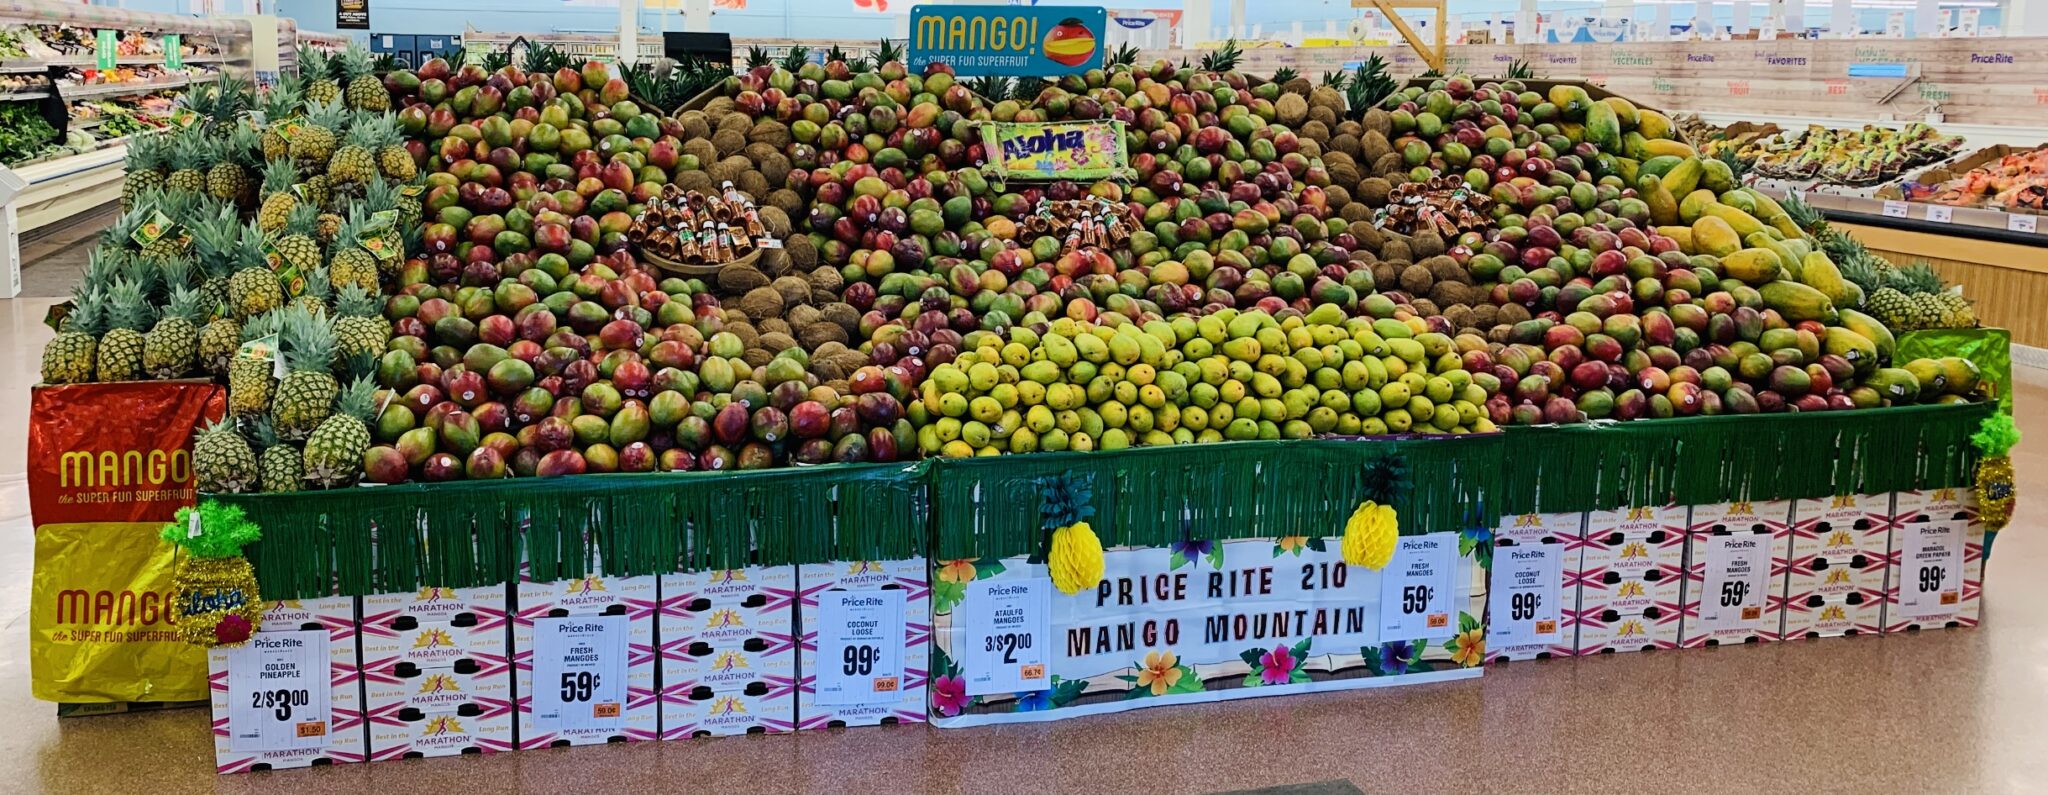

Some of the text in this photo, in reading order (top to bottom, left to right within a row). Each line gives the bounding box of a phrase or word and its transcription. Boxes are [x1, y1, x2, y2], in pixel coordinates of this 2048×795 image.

[916, 15, 1038, 55] MANGO!
[913, 55, 1028, 67] the SUPER FUN SUPERFRUIT
[1613, 57, 1653, 66] VEGETABLES
[1767, 57, 1806, 66] FAVORITES
[1729, 87, 1750, 96] FRUIT
[1920, 90, 1950, 100] FRESH
[1002, 128, 1085, 161] Aloha
[60, 449, 198, 488] MANGO
[58, 488, 193, 504] the SUPER FUN SUPERFRUIT
[1825, 511, 1862, 519] MARATHON
[1508, 528, 1549, 536] MARATHON
[1920, 526, 1951, 535] Price Rite
[1403, 540, 1439, 550] Price Rite
[1724, 540, 1756, 549] Price Rite
[1511, 550, 1530, 560] Price
[1915, 552, 1932, 560] GREEN
[1613, 560, 1653, 568] MARATHON
[1406, 569, 1434, 577] MANGOES
[1514, 570, 1541, 578] COCONUT
[840, 574, 889, 585] MARATHON
[1096, 560, 1348, 608] PRICE RITE 210
[1919, 565, 1946, 593] 99¢
[703, 585, 755, 595] MARATHON
[988, 585, 1029, 596] Price Rite
[1720, 580, 1750, 607] 59¢
[1818, 584, 1855, 593] MARATHON
[561, 596, 615, 606] MARATHON
[841, 596, 884, 607] Price Rite
[1402, 585, 1434, 615] 59¢
[1612, 599, 1651, 607] MARATHON
[408, 603, 464, 612] MARATHON
[1511, 592, 1542, 621] 99¢
[261, 612, 310, 622] ARATHON
[995, 608, 1023, 617] ATAULFO
[847, 620, 879, 628] COCONUT
[993, 616, 1025, 625] MANGOES
[1814, 621, 1852, 629] MARATHON
[558, 622, 604, 633] Price Rite
[852, 628, 873, 636] LOOSE
[1067, 606, 1366, 657] MANGO MOUNTAIN
[52, 629, 185, 643] the SUPER FUN SUPERFRU
[701, 628, 752, 639] MARATHON
[254, 637, 303, 649] Price Rite
[1610, 637, 1649, 645] MARATHON
[408, 648, 463, 658] MARATHON
[570, 646, 594, 655] FRESH
[1504, 644, 1545, 653] MARATHON
[563, 653, 599, 663] MANGOES
[843, 645, 880, 676] 99¢
[265, 663, 296, 671] GOLDEN
[260, 670, 301, 679] PINEAPPLE
[704, 672, 755, 682] MARATHON
[561, 671, 601, 703] 59¢
[412, 693, 467, 704] MARATHON
[838, 707, 888, 716] MARATHON
[704, 715, 755, 725] MARATHON
[300, 725, 321, 734] $1.50
[416, 735, 470, 746] MARATHON
[264, 748, 320, 759] MARATHON
